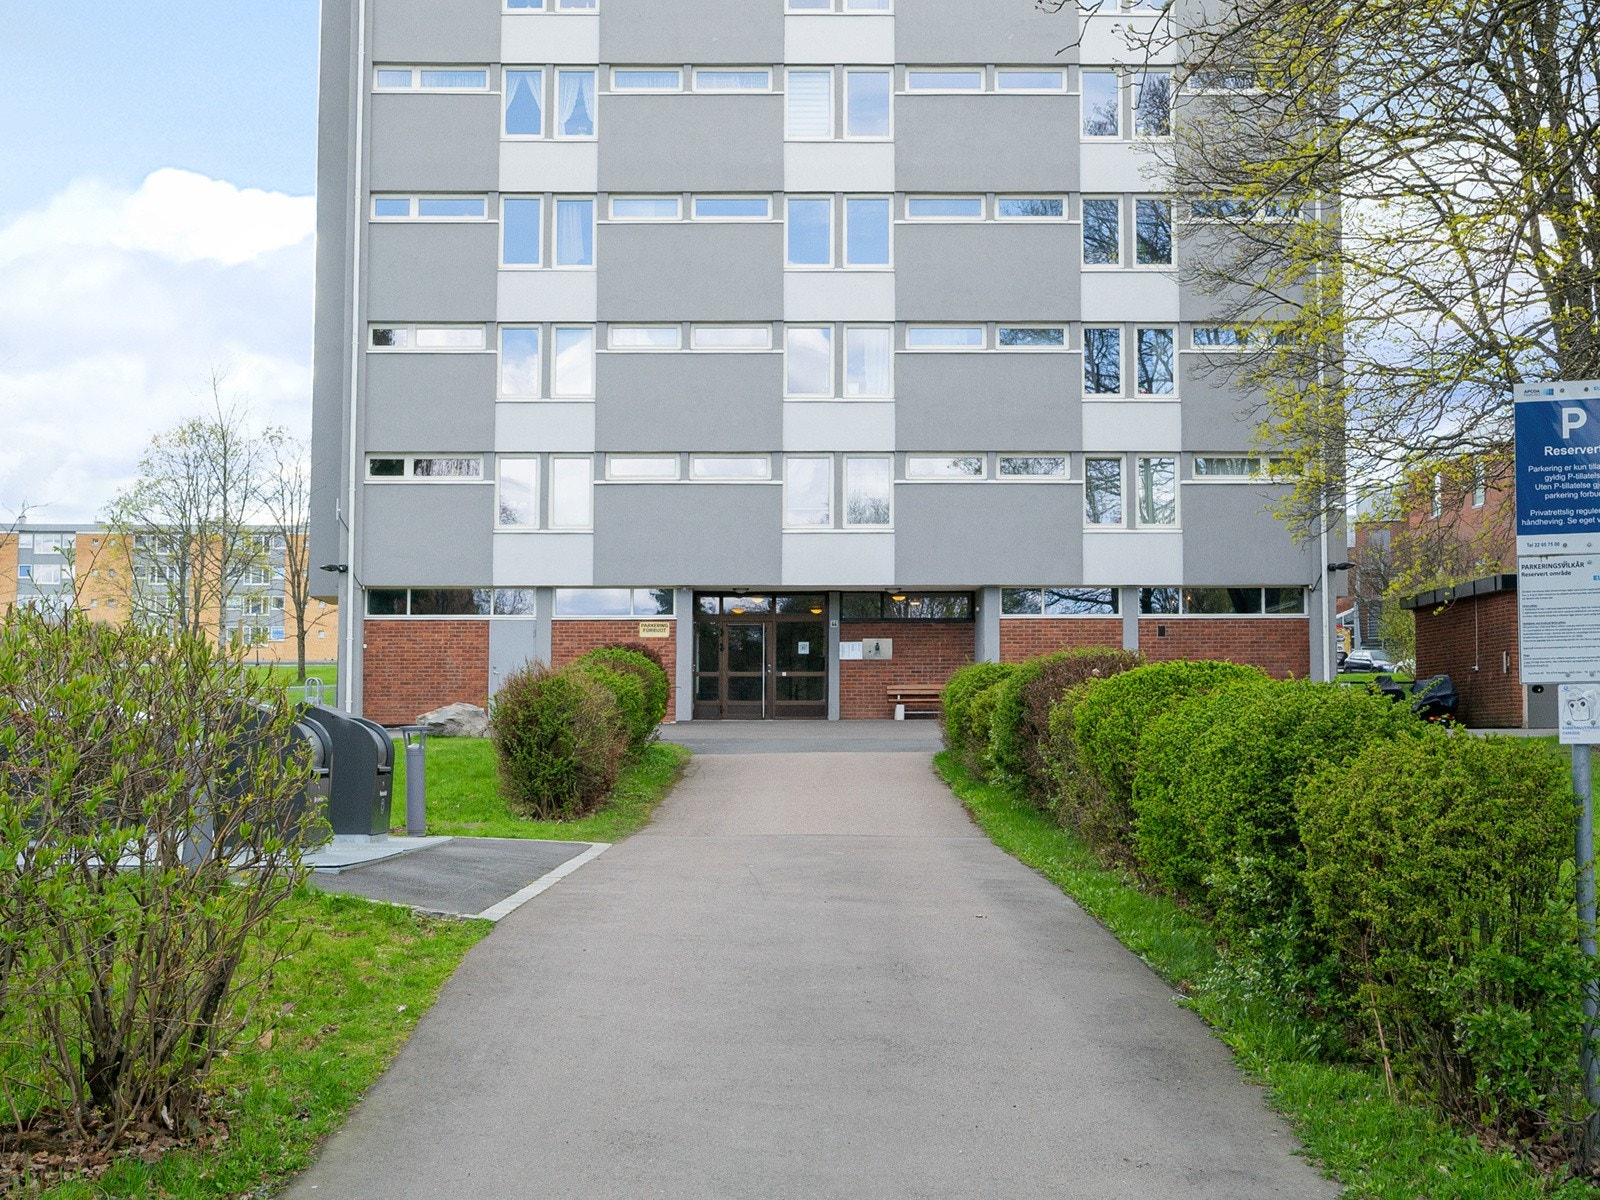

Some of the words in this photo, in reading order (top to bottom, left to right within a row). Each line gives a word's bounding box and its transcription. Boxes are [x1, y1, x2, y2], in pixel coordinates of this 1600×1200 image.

[1562, 407, 1587, 439] P
[1528, 465, 1563, 473] Parkering
[1544, 473, 1566, 482] gyldig
[1554, 482, 1591, 490] P-tillatelse
[1544, 492, 1578, 501] parkering
[1530, 509, 1575, 517] Privatrettslig
[1521, 518, 1565, 526] håndheving.
[1579, 516, 1595, 525] eget
[1521, 560, 1585, 570] PARKERINGSVILKÅR
